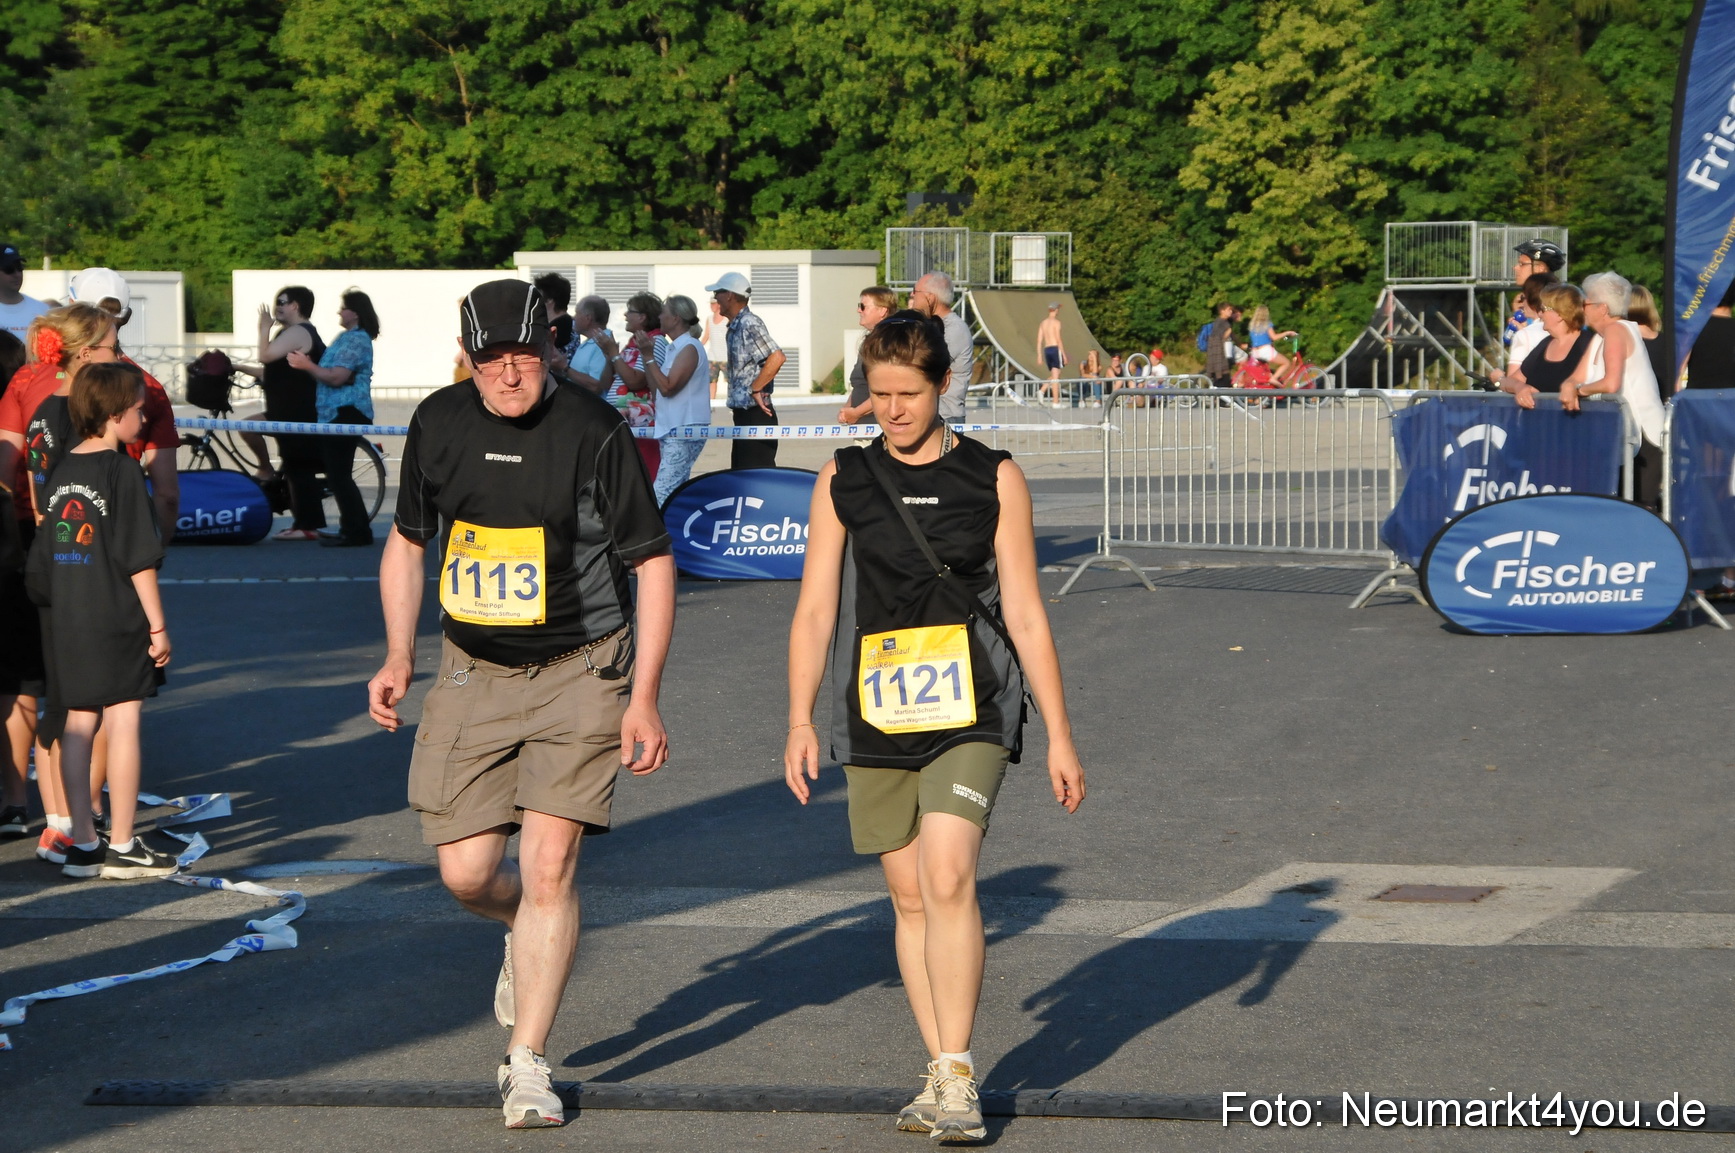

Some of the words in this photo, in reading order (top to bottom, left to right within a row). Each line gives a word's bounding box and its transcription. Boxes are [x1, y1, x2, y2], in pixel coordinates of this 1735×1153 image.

[1453, 468, 1571, 511] Fisch
[176, 506, 247, 530] cher
[176, 525, 241, 537] OMOBILE
[712, 517, 809, 544] Fisch
[722, 544, 805, 556] AUTOMOB
[447, 557, 539, 601] 1113
[1491, 555, 1656, 590] Fischer
[474, 601, 488, 609] Ernst
[1507, 588, 1643, 607] AUTOMOBILE
[459, 607, 477, 615] Regens
[864, 661, 962, 708] 1121
